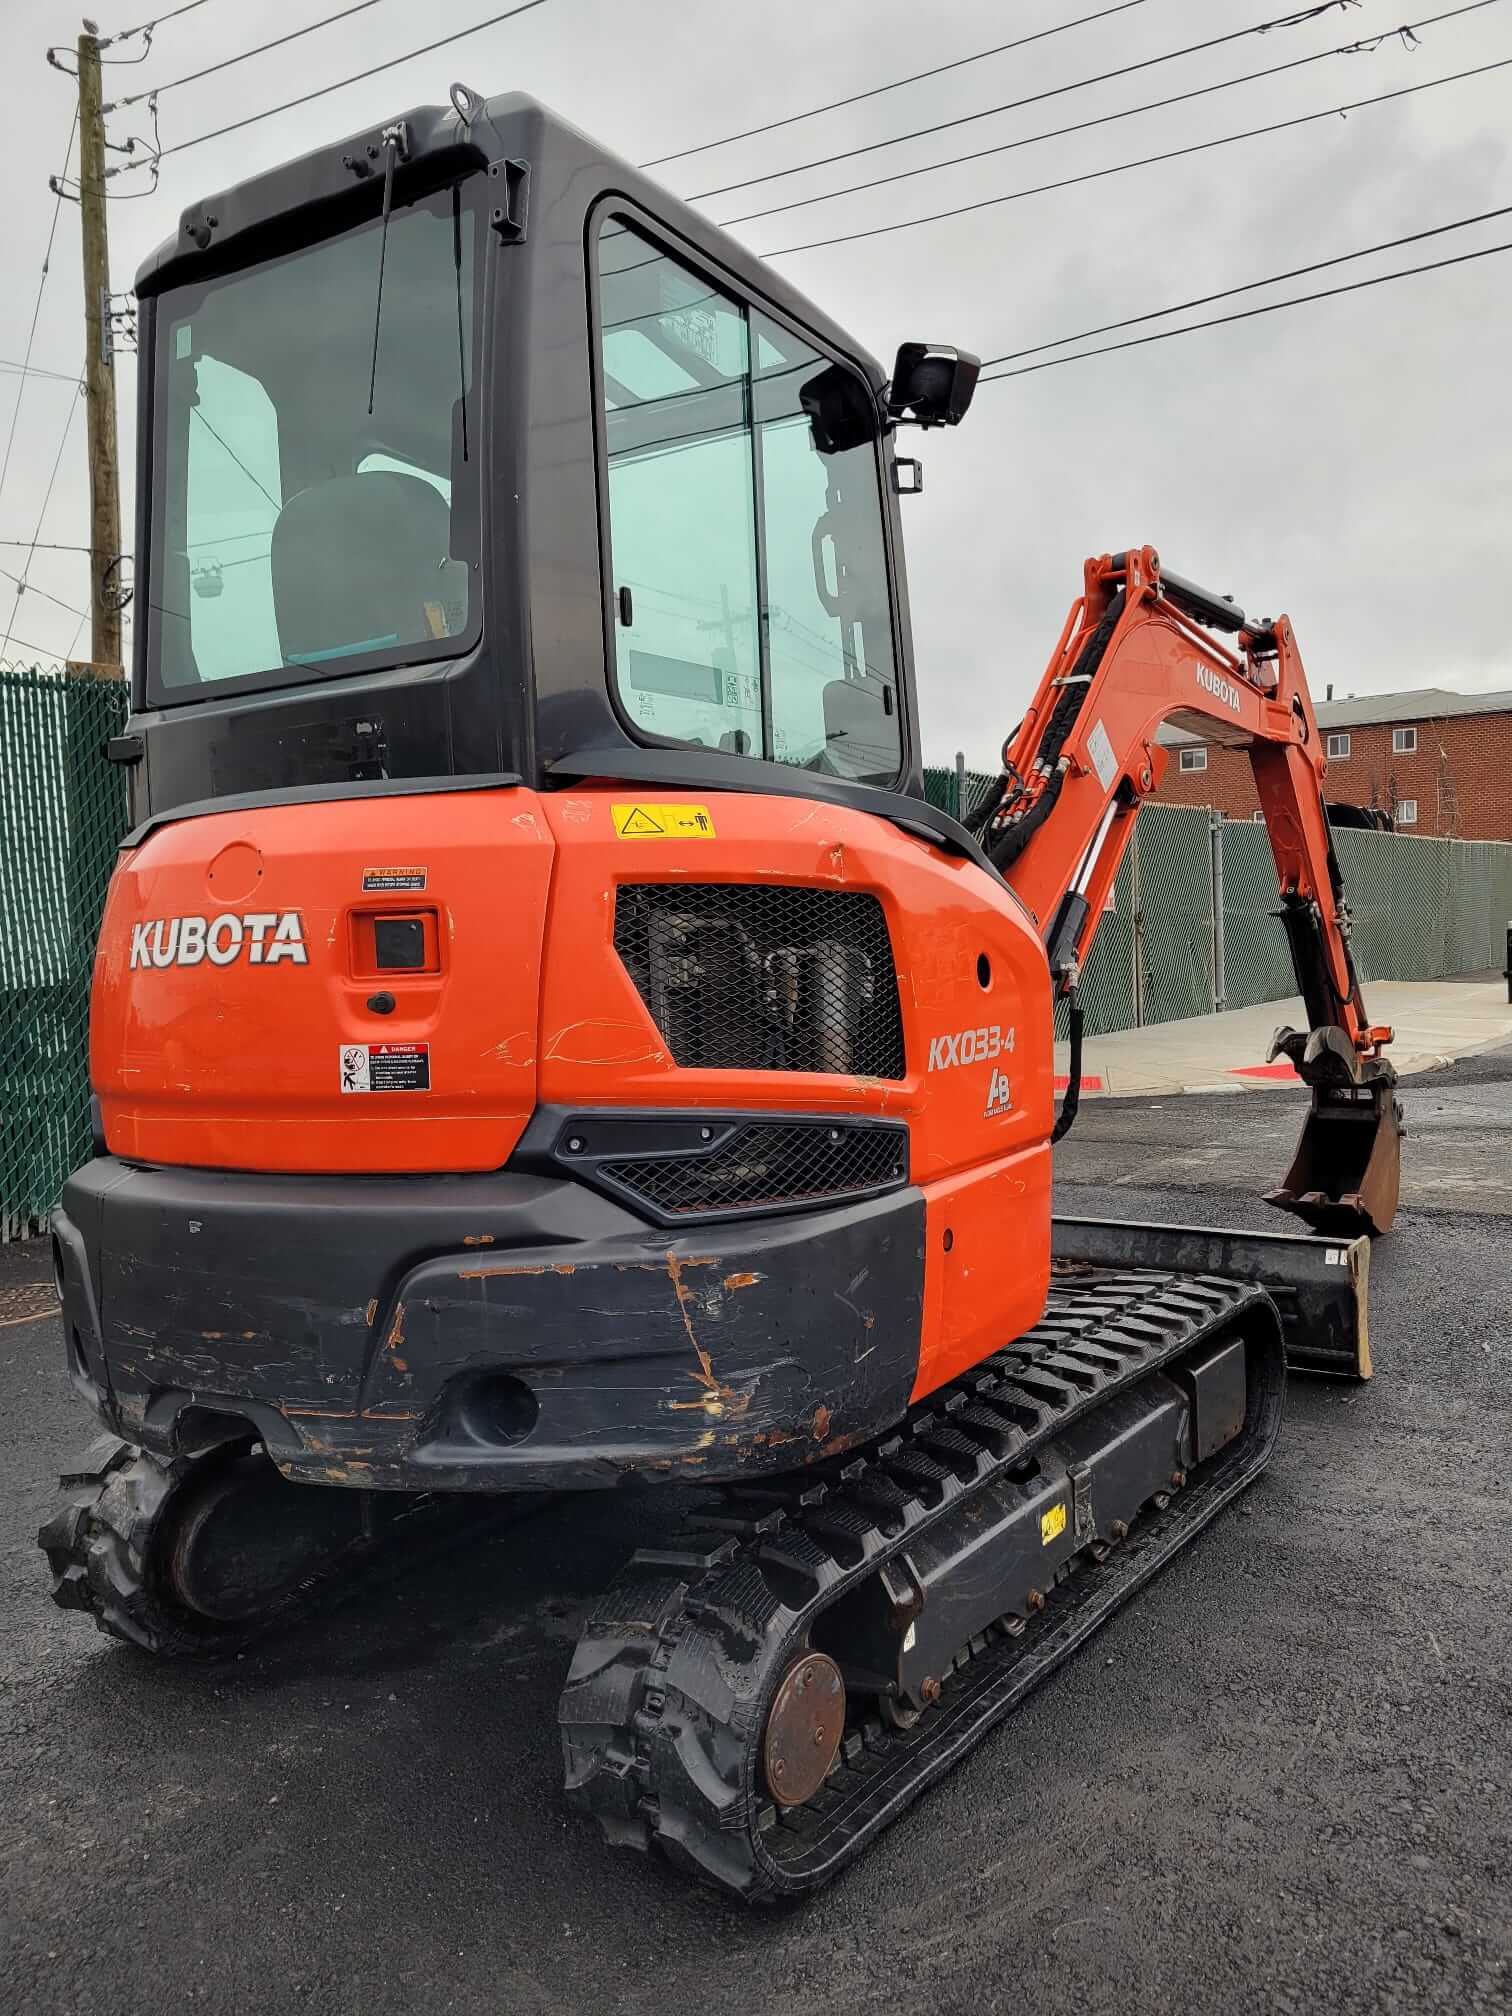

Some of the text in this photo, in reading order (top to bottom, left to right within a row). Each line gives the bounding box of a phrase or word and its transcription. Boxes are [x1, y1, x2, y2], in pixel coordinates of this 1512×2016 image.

[1196, 662, 1241, 712] KUBOTA
[379, 868, 422, 876] WARNING
[130, 912, 308, 970] KUBOTA
[928, 1026, 1015, 1072] KX033-4
